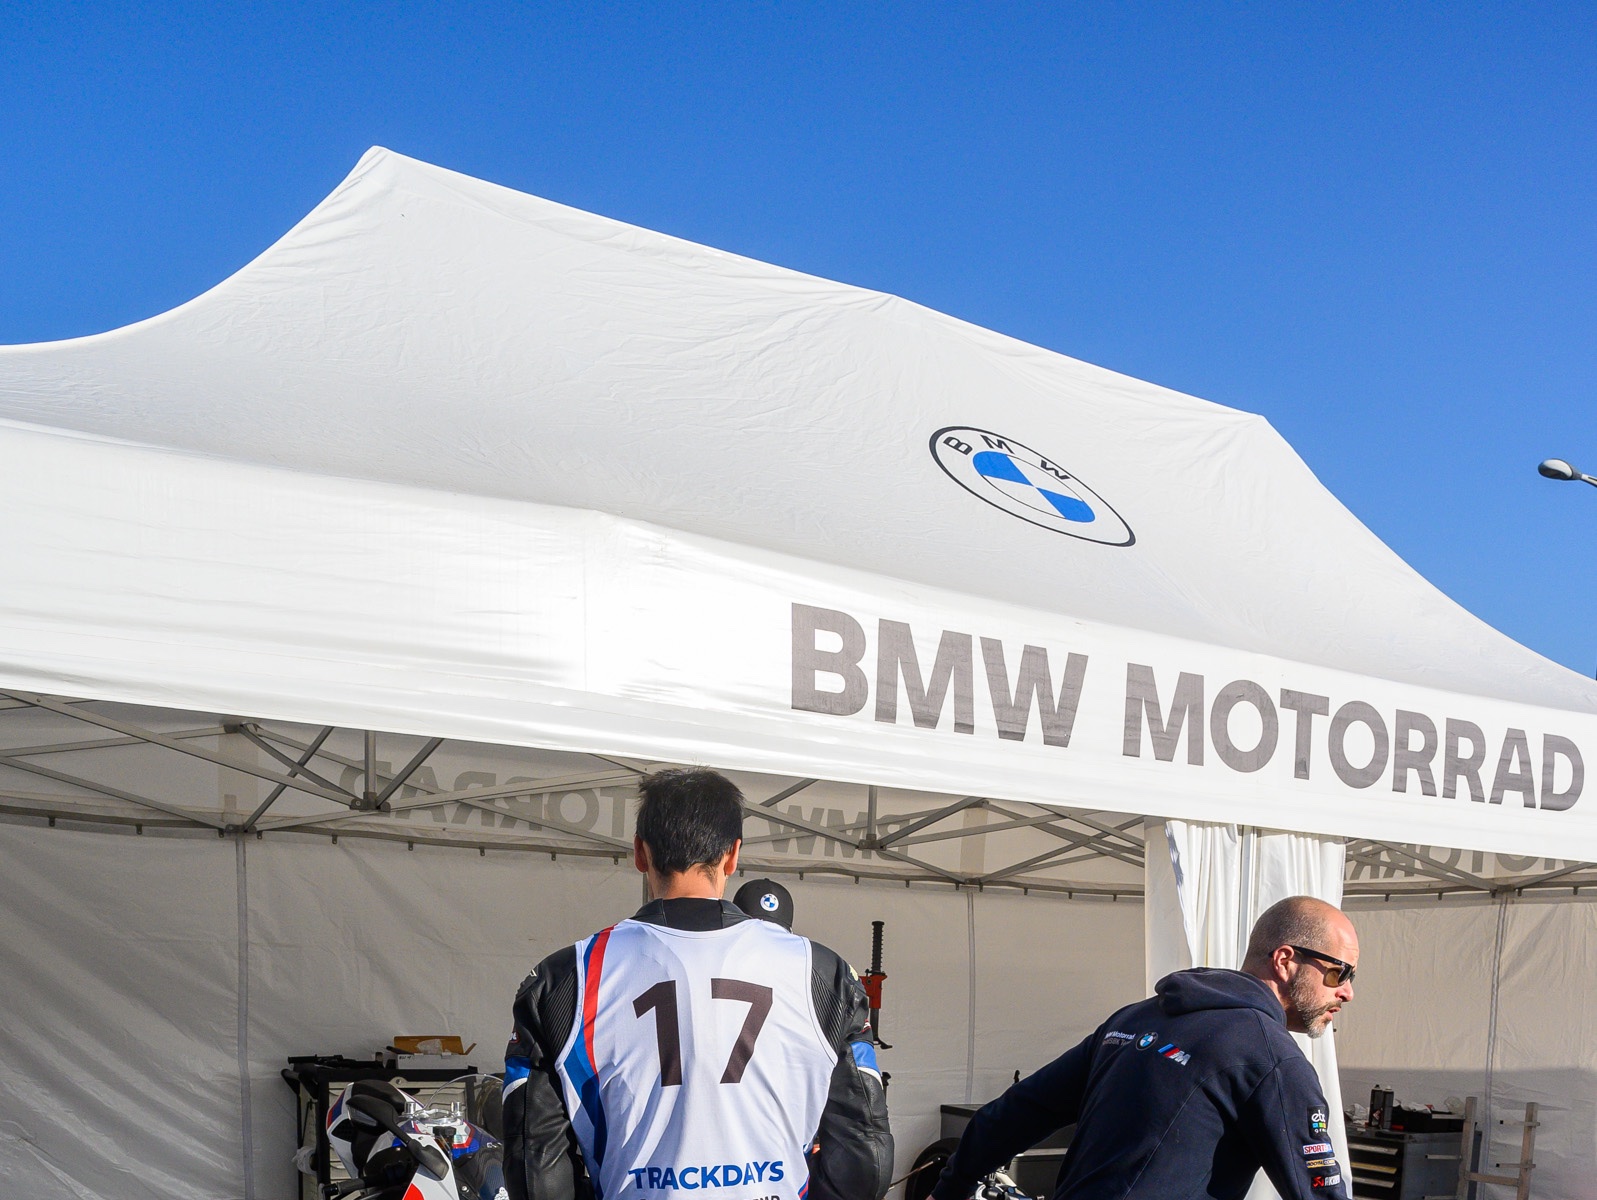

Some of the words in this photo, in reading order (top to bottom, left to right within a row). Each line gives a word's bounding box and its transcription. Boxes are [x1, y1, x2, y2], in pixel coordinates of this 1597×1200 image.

[943, 434, 1070, 480] BMW
[791, 602, 1089, 748] BMW
[1122, 662, 1585, 811] MOTORRAD
[632, 978, 774, 1088] 17
[628, 1161, 785, 1190] TRACKDAYS
